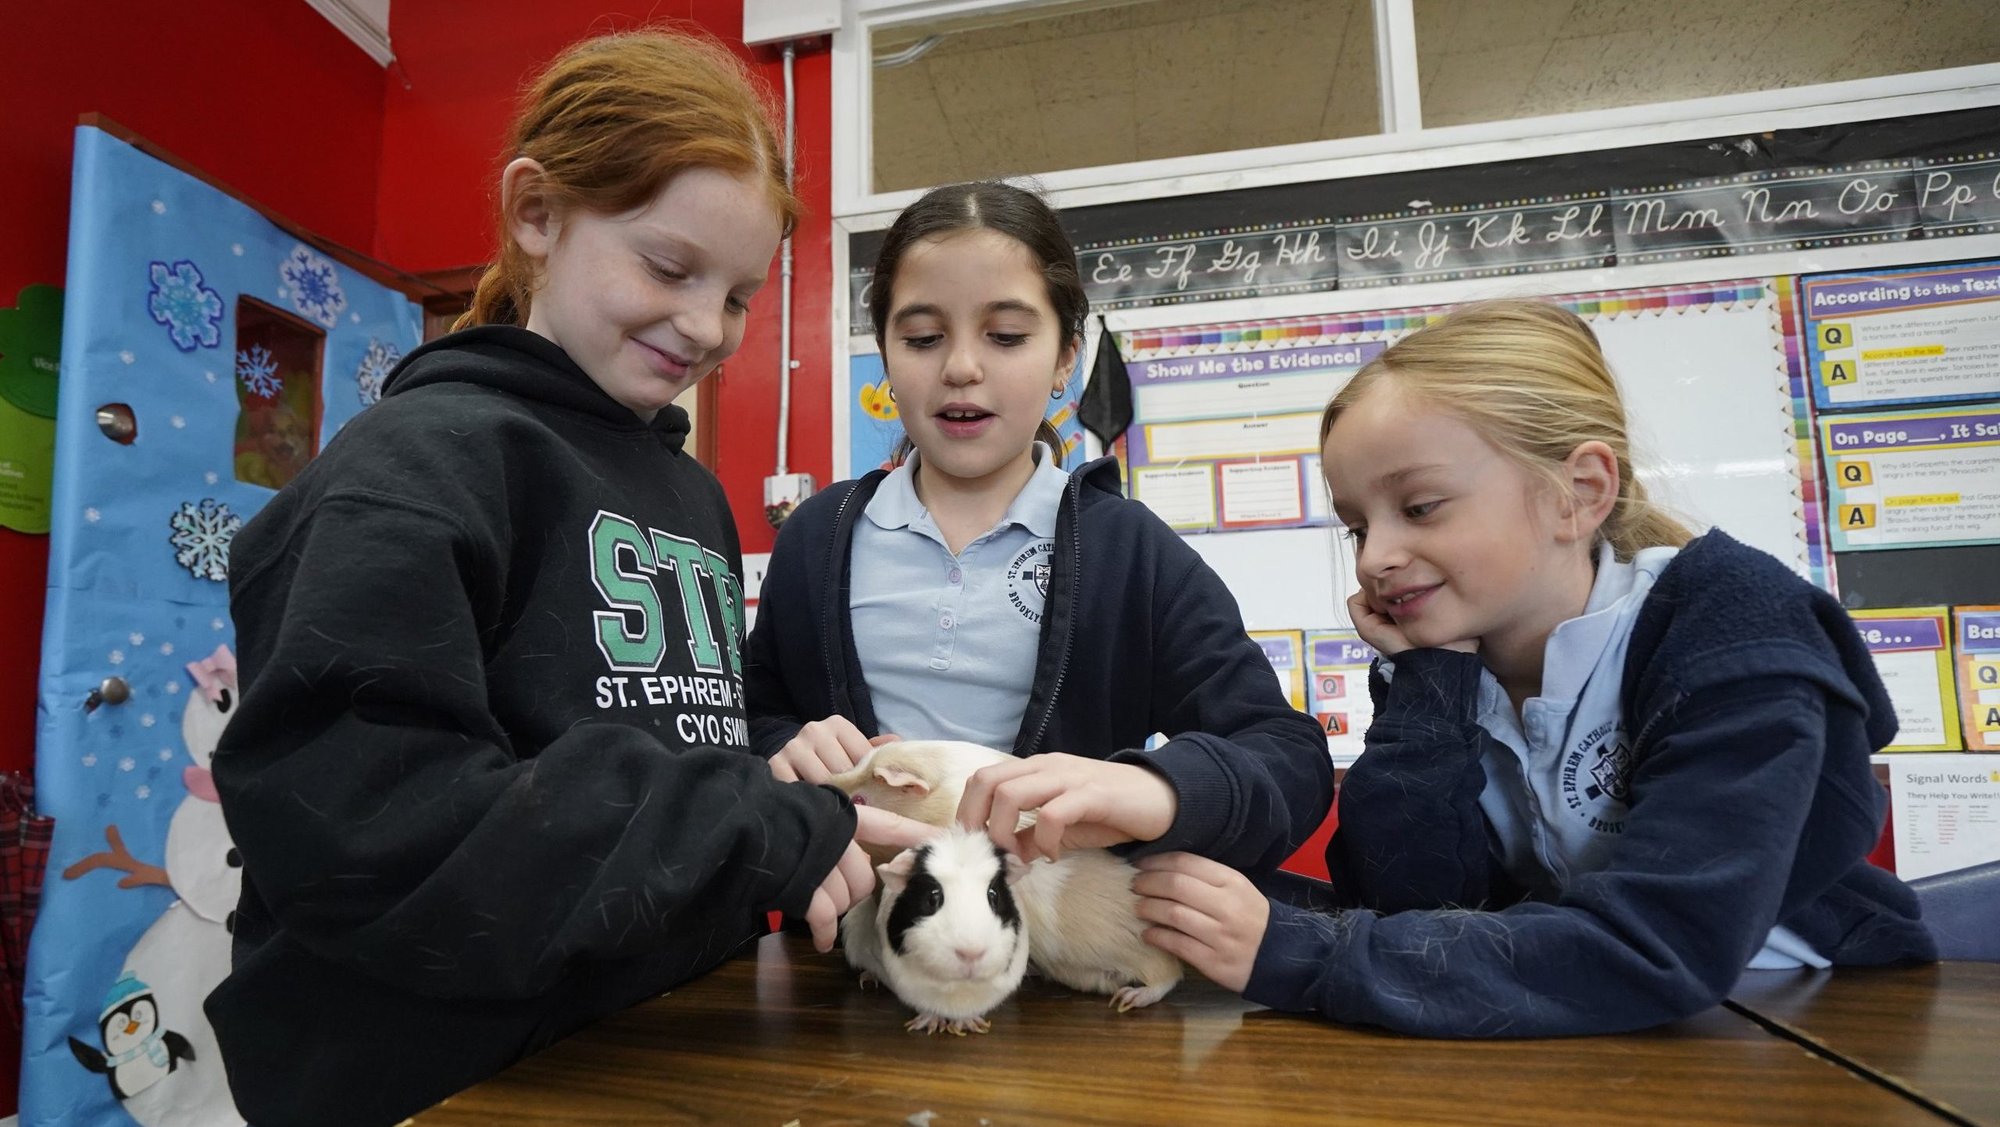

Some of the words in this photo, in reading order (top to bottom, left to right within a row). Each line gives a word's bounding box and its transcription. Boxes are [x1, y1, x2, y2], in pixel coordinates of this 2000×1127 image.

[1092, 252, 1132, 284] Ee
[1145, 244, 1196, 290] Ff
[1207, 240, 1262, 282] Gg
[1273, 231, 1325, 267] Hh
[1347, 226, 1402, 260] Ii
[1414, 220, 1452, 269] Jj
[1466, 212, 1531, 249] Kk
[1546, 203, 1604, 241] Ll
[1624, 199, 1726, 235] Mm
[1742, 187, 1820, 223] Nn
[1838, 178, 1900, 215] Oo
[1921, 171, 1977, 222] Pp
[1813, 285, 1911, 306] According
[1913, 287, 1931, 297] to
[1934, 283, 1960, 295] the
[1825, 328, 1842, 345] Q
[1146, 362, 1194, 379] Show
[1198, 358, 1226, 375] Me
[1231, 356, 1265, 373] the
[1269, 347, 1362, 371] Evidence!
[1831, 364, 1847, 381] A
[1835, 431, 1859, 445] On
[1951, 424, 1970, 438] It
[1844, 465, 1862, 482] Q
[1849, 507, 1865, 525] A
[1011, 546, 1038, 570] EPHREM
[1341, 644, 1369, 659] For
[1978, 665, 1998, 684] Q
[595, 675, 637, 709] ST.
[1322, 678, 1337, 695] Q
[1326, 716, 1341, 732] A
[1985, 708, 2000, 726] A
[676, 713, 721, 745] CYO
[1563, 751, 1585, 793] EPHREM
[1906, 773, 1944, 785] Signal
[1947, 773, 1988, 784] Words
[1907, 792, 1927, 800] They
[1929, 792, 1949, 800] Help
